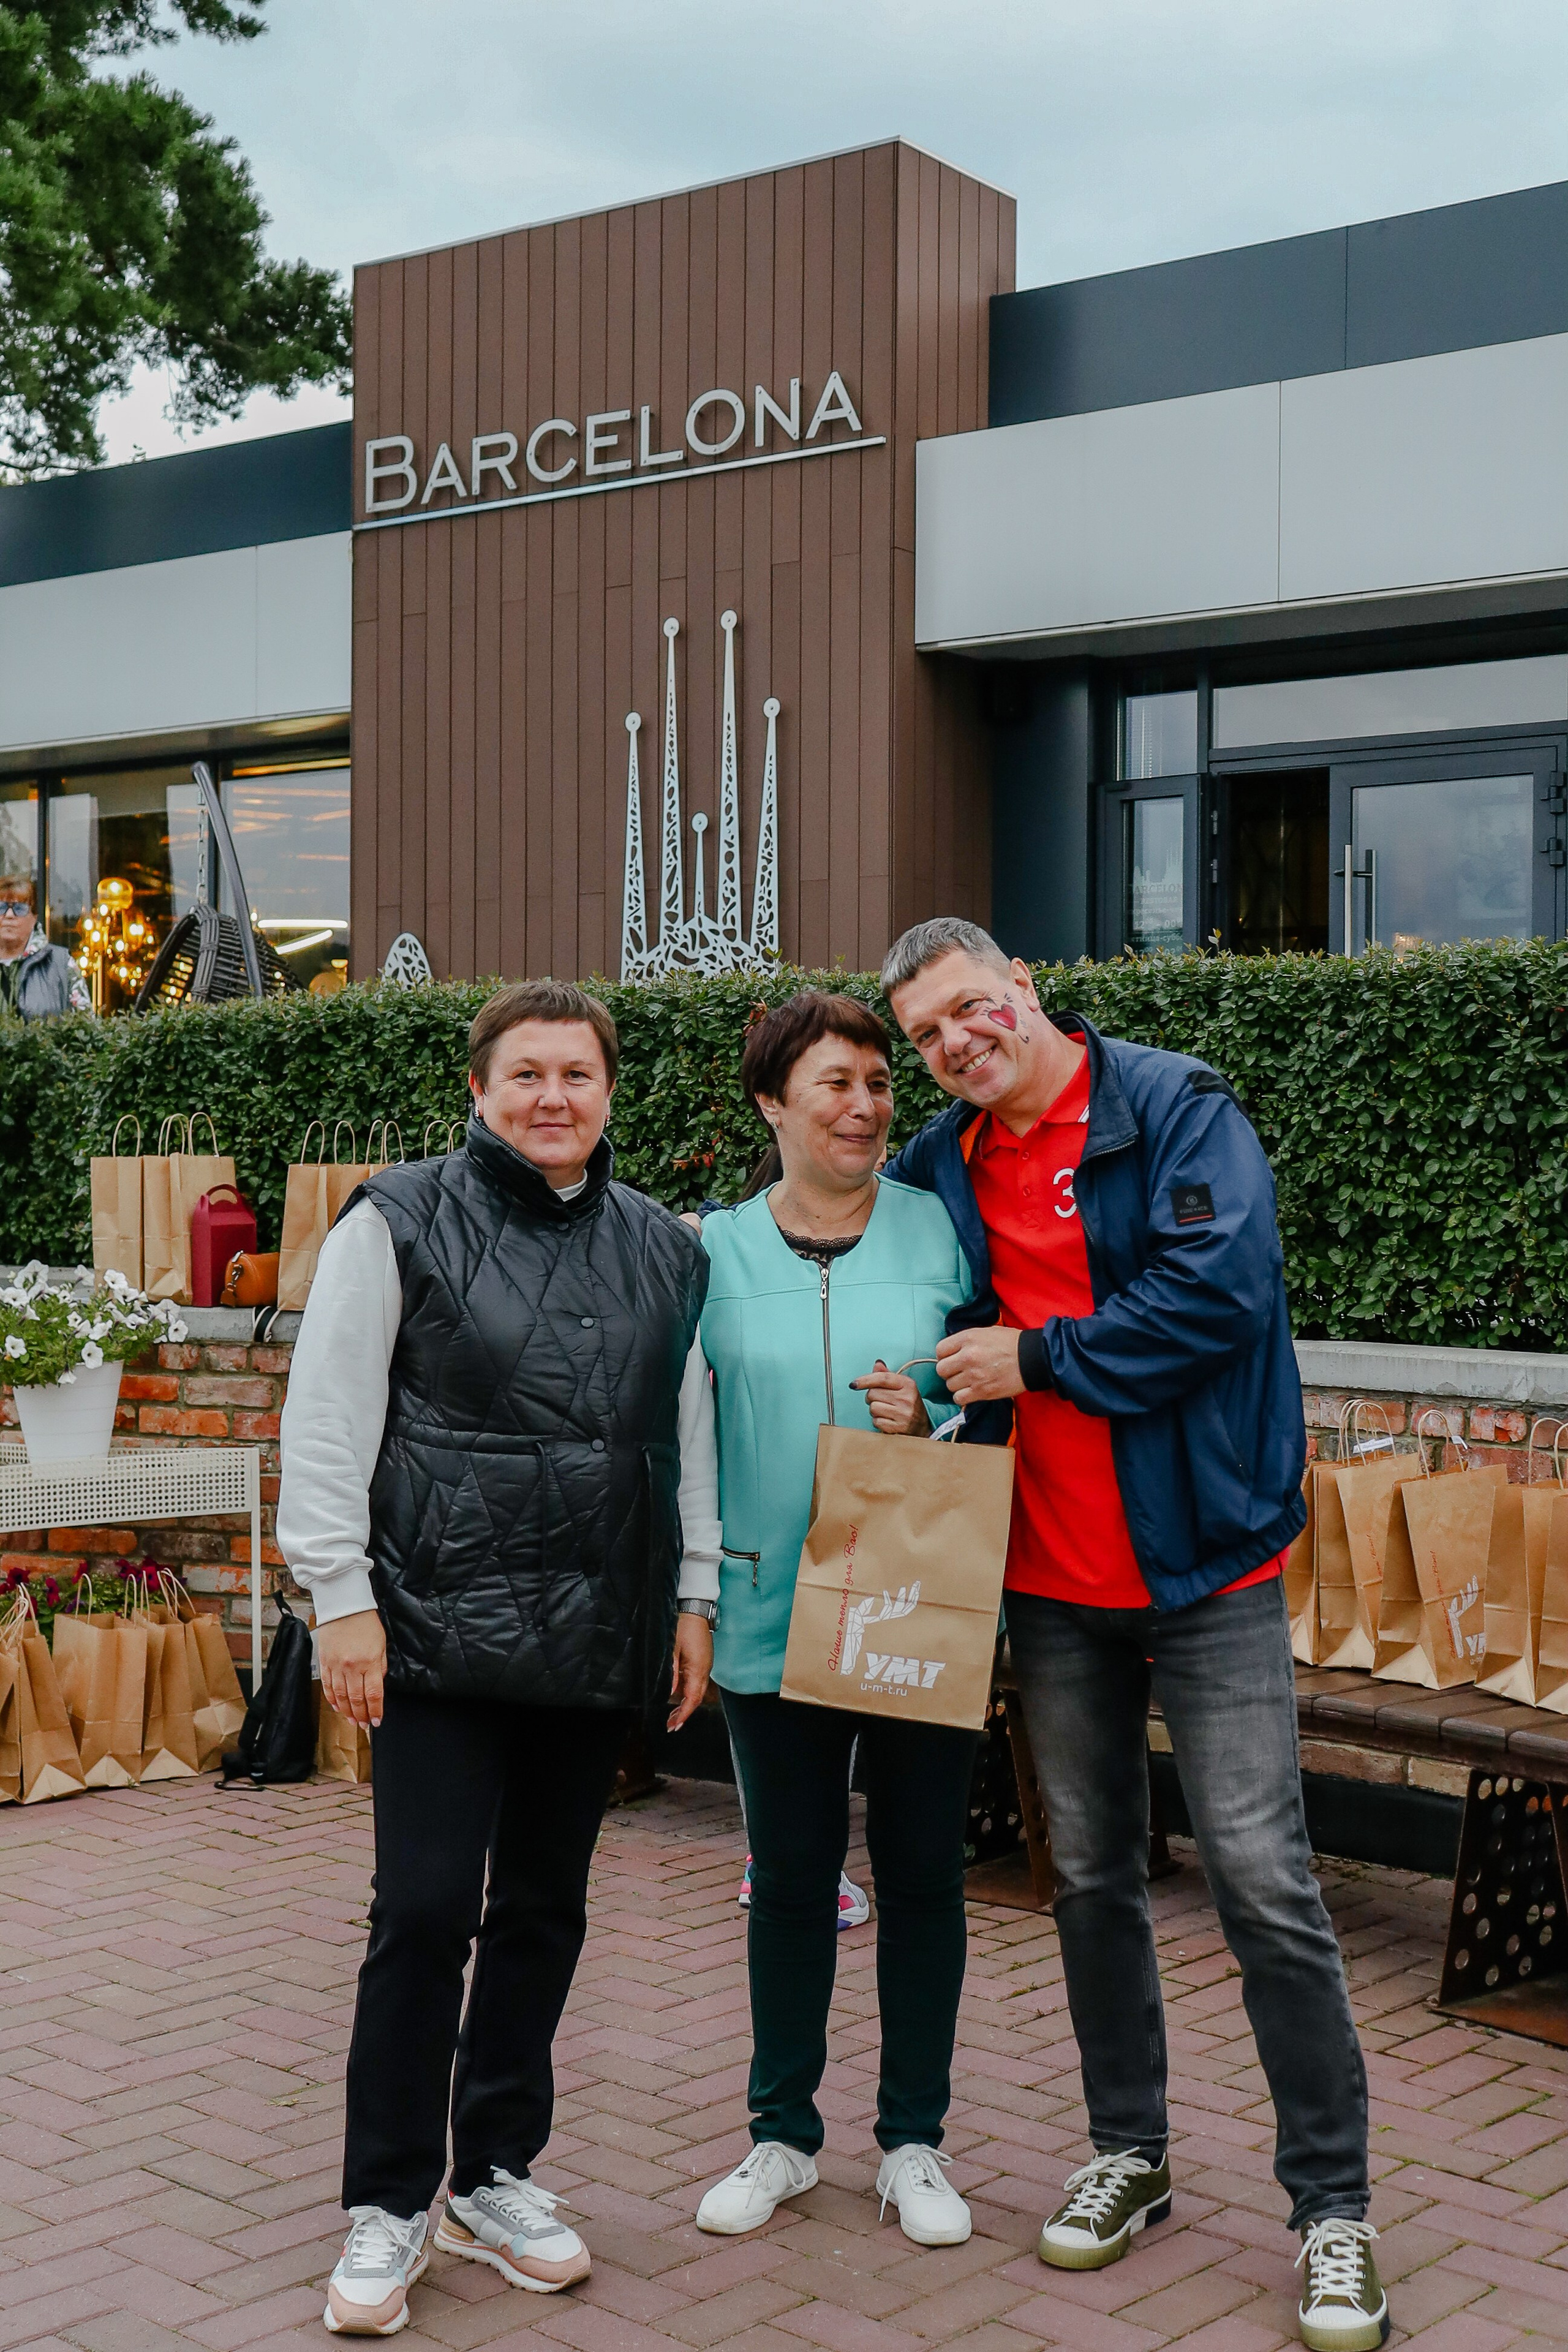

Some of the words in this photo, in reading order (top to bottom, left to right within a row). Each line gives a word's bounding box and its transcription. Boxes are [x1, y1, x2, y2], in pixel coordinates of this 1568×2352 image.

[364, 371, 863, 513] BARCELONA
[837, 1588, 850, 1627] тепло
[844, 1562, 854, 1586] для
[860, 1682, 908, 1697] u-m-t.ru
